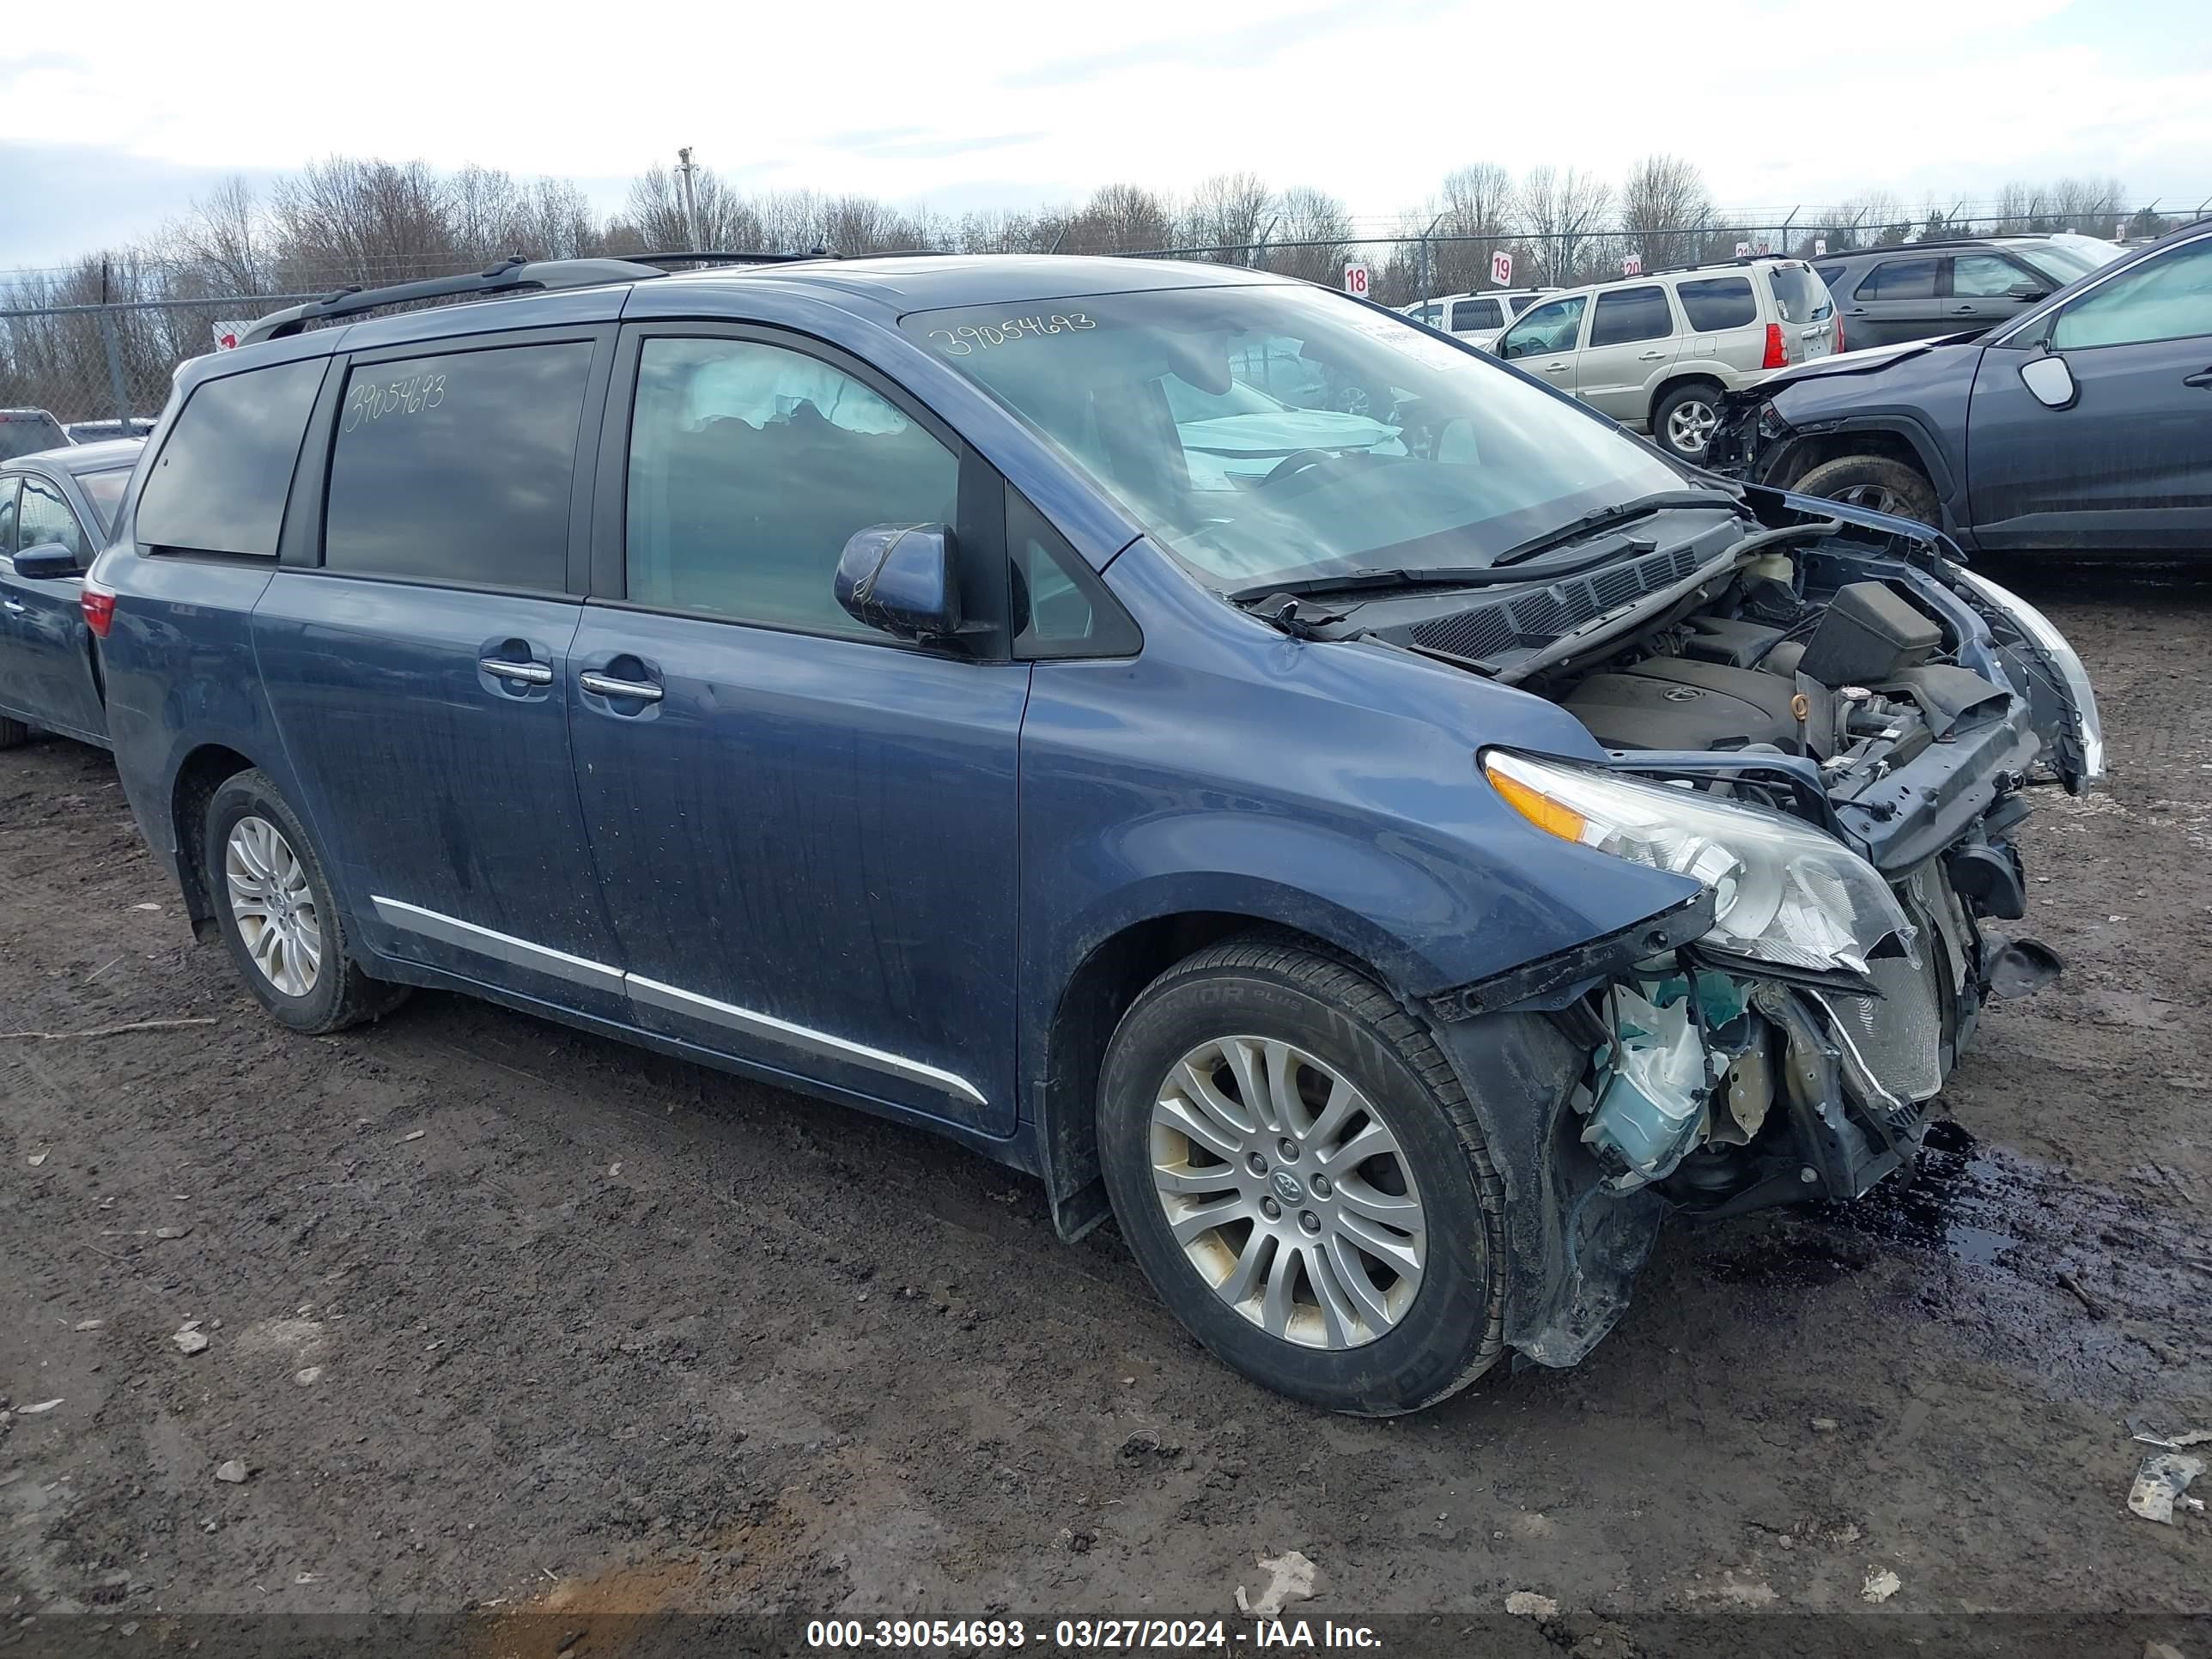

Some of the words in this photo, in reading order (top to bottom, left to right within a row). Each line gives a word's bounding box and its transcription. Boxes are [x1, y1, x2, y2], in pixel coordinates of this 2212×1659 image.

[1494, 258, 1510, 280] 19
[1346, 270, 1366, 292] 18
[928, 313, 1097, 356] 39054693
[345, 374, 447, 433] 39054693
[1254, 989, 1304, 1011] PLUS
